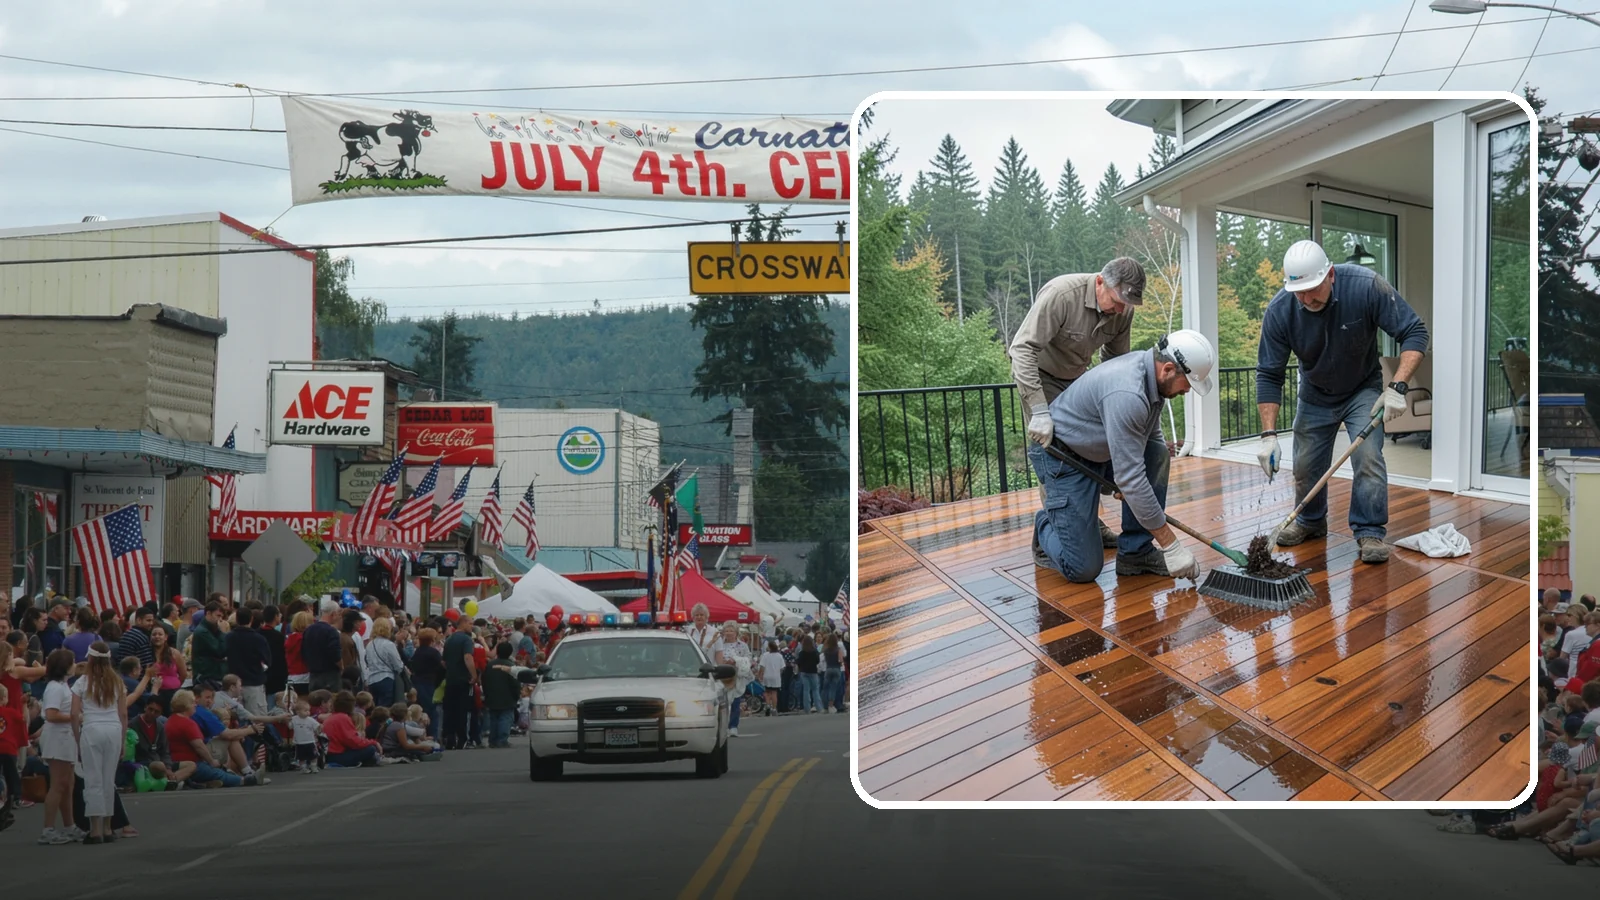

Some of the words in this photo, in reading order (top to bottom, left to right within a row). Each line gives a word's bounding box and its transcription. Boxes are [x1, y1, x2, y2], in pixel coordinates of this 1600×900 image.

[695, 121, 850, 149] Carnat
[481, 141, 605, 192] JULY
[632, 150, 746, 198] 4th.
[697, 254, 850, 280] CROSSWA
[283, 380, 374, 420] ACE
[405, 409, 453, 422] CEDAR
[461, 409, 485, 422] LOG
[284, 421, 371, 436] Hardware
[416, 428, 477, 447] Coca-Cola
[353, 467, 385, 479] Simpl
[96, 485, 124, 495] Vincent
[126, 486, 136, 495] de
[137, 486, 155, 495] Paul
[212, 516, 331, 535] HARDARE
[688, 526, 742, 535] CRNATION
[699, 535, 730, 543] GLASS
